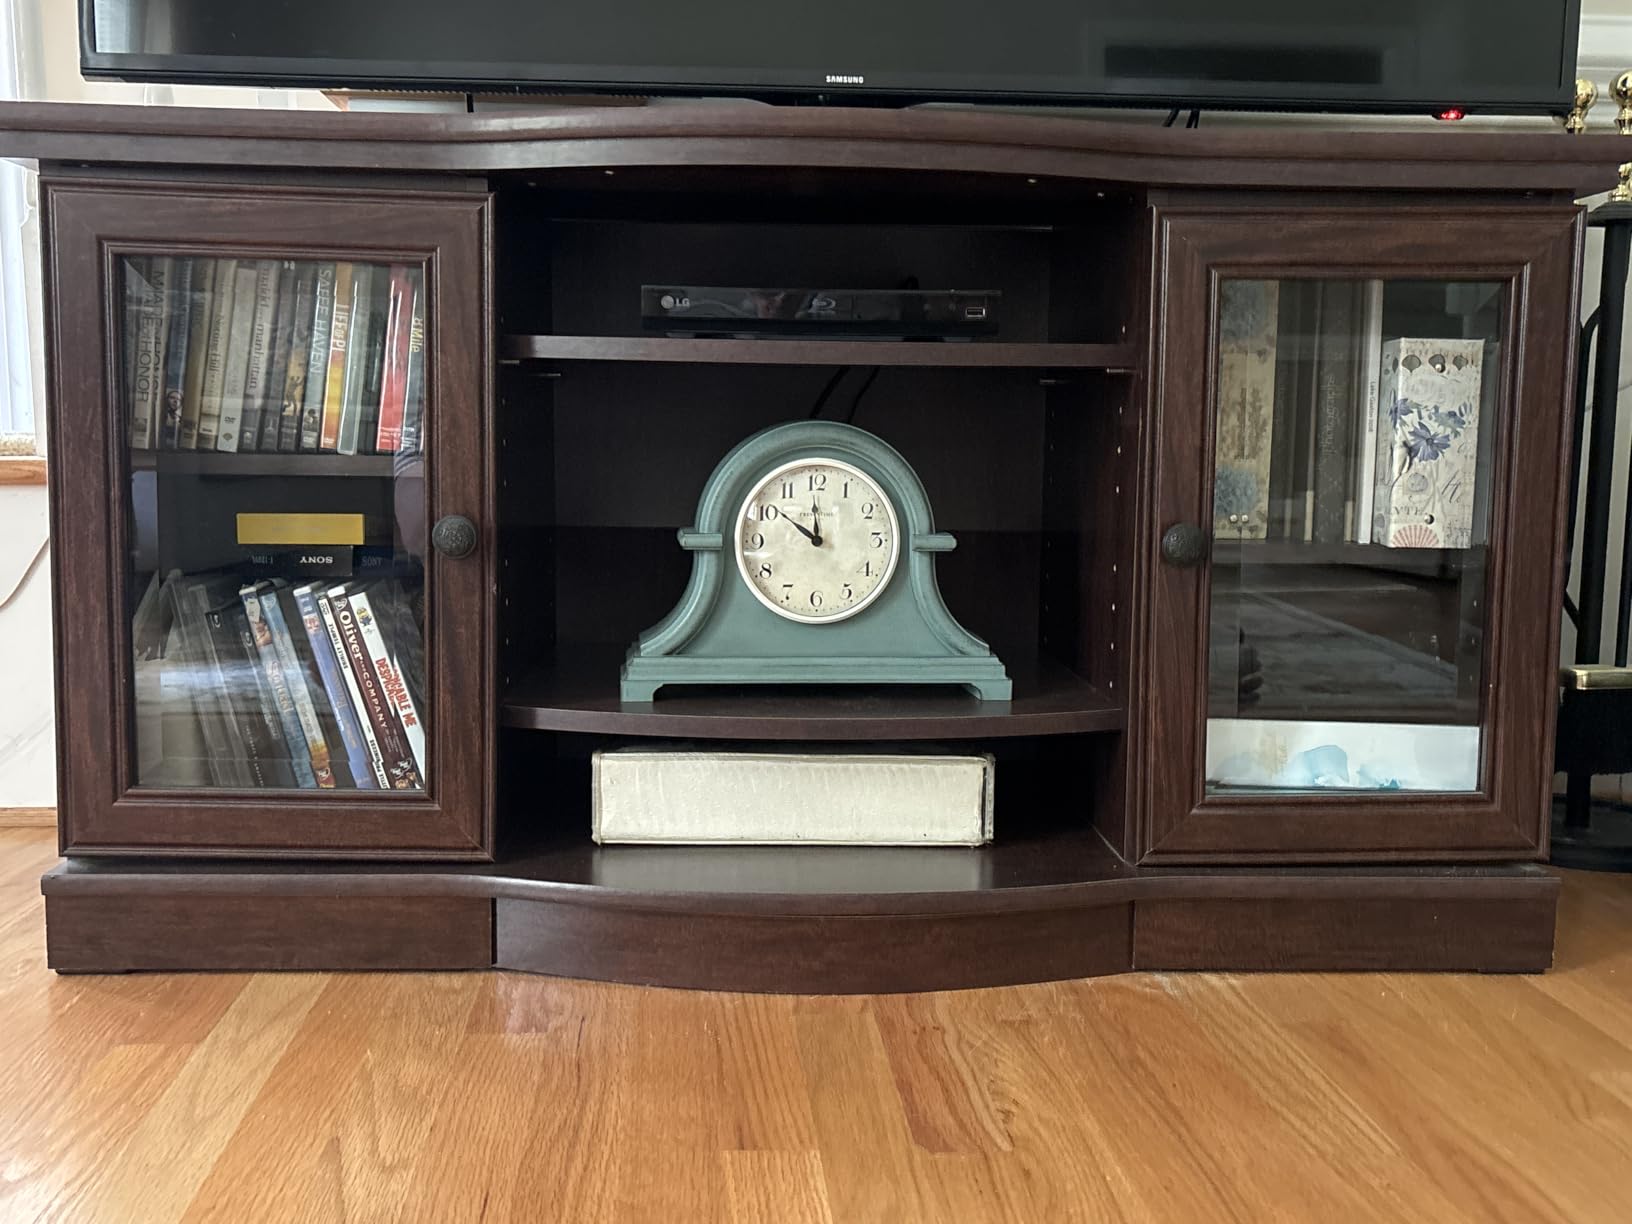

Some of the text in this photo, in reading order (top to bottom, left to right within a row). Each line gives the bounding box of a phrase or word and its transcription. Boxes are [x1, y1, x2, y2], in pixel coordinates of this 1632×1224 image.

[826, 75, 864, 84] SAMSUNG
[675, 298, 690, 308] LG
[310, 320, 329, 374] HAVEN
[332, 339, 346, 352] PI
[411, 327, 424, 353] Mile
[782, 482, 793, 499] 11
[808, 474, 827, 491] 12
[843, 481, 848, 498] 1
[759, 503, 778, 521] 10
[861, 503, 873, 519] 2
[751, 533, 764, 549] 9
[870, 532, 883, 548] 3
[299, 556, 333, 564] SONY
[759, 563, 772, 579] 8
[856, 561, 873, 577] 4
[783, 584, 794, 600] 7
[810, 591, 823, 607] 6
[840, 583, 852, 600] 5
[340, 611, 387, 728] Oliver COMPANY
[403, 712, 418, 728] ME
